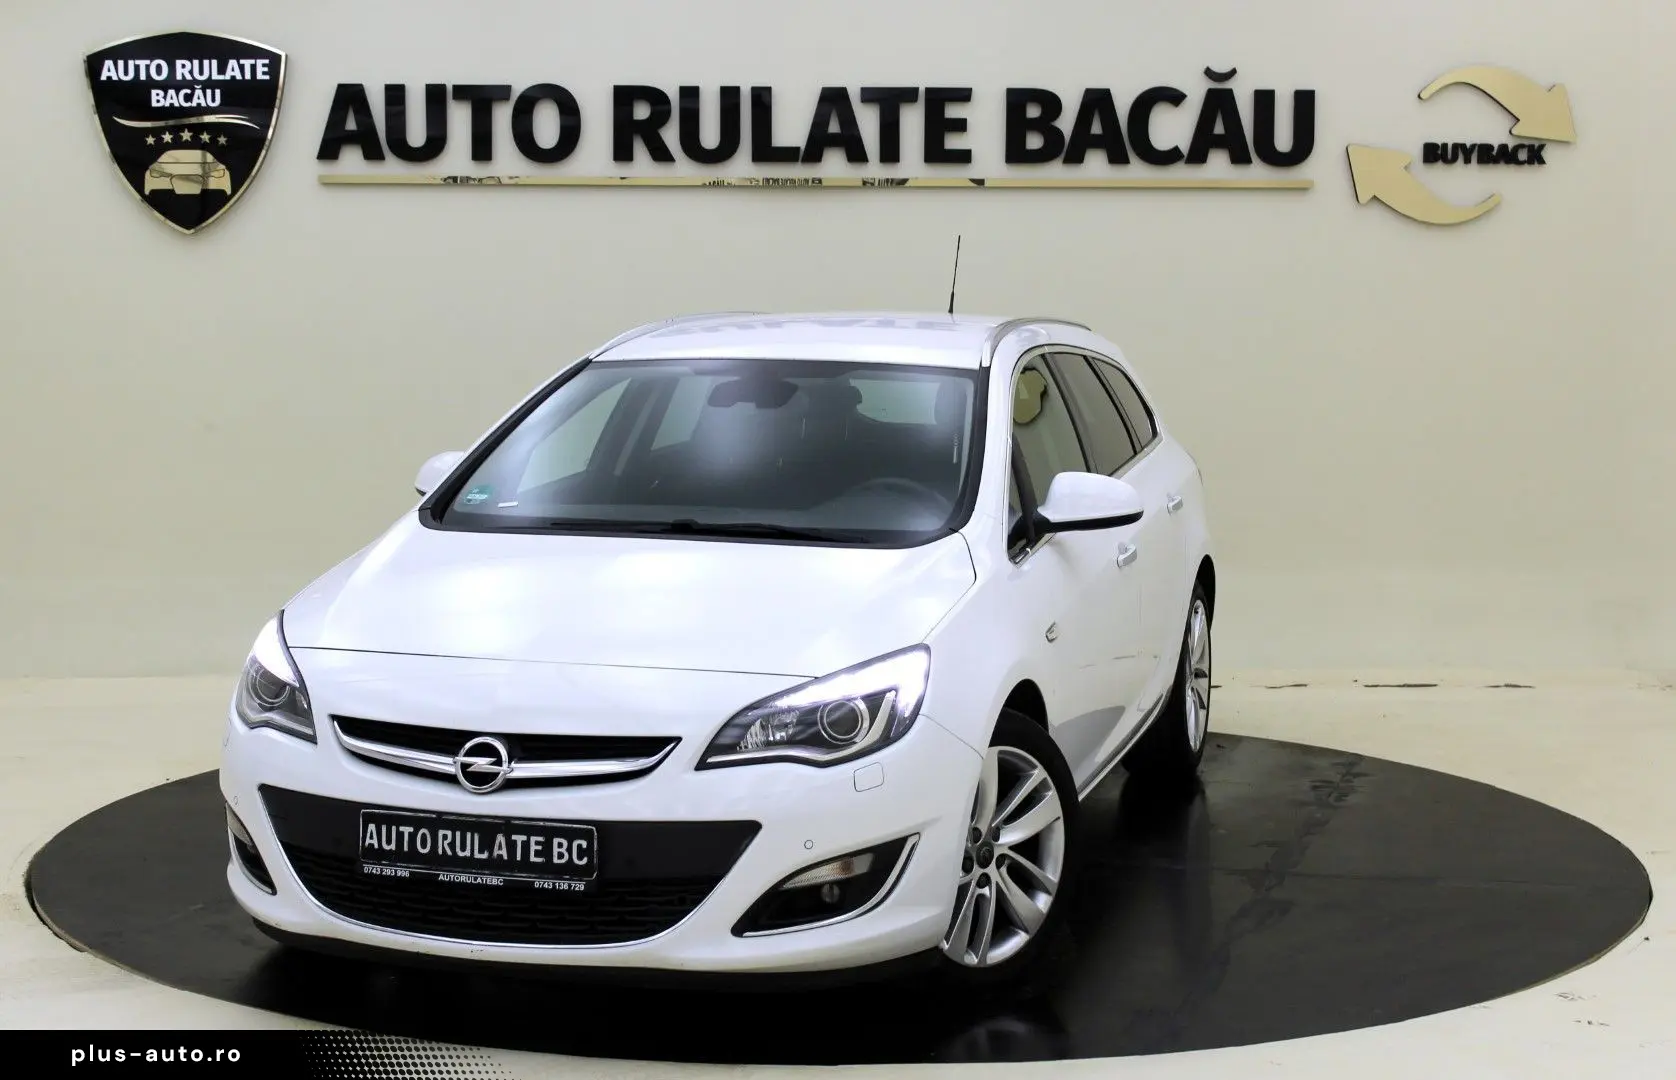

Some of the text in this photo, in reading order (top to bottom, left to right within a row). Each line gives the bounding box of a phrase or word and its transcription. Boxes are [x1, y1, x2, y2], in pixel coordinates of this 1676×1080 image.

[101, 59, 270, 80] AUTO RULATE
[150, 85, 221, 108] BACĂU
[316, 66, 1316, 168] AUTO RULATE BACĂU
[1422, 142, 1547, 165] BUYBACK
[364, 823, 588, 866] AUTO RULATE BC
[364, 866, 380, 874] 0743
[438, 874, 504, 886] AUTORULATEBC
[555, 882, 569, 890] 136
[570, 883, 585, 891] 729
